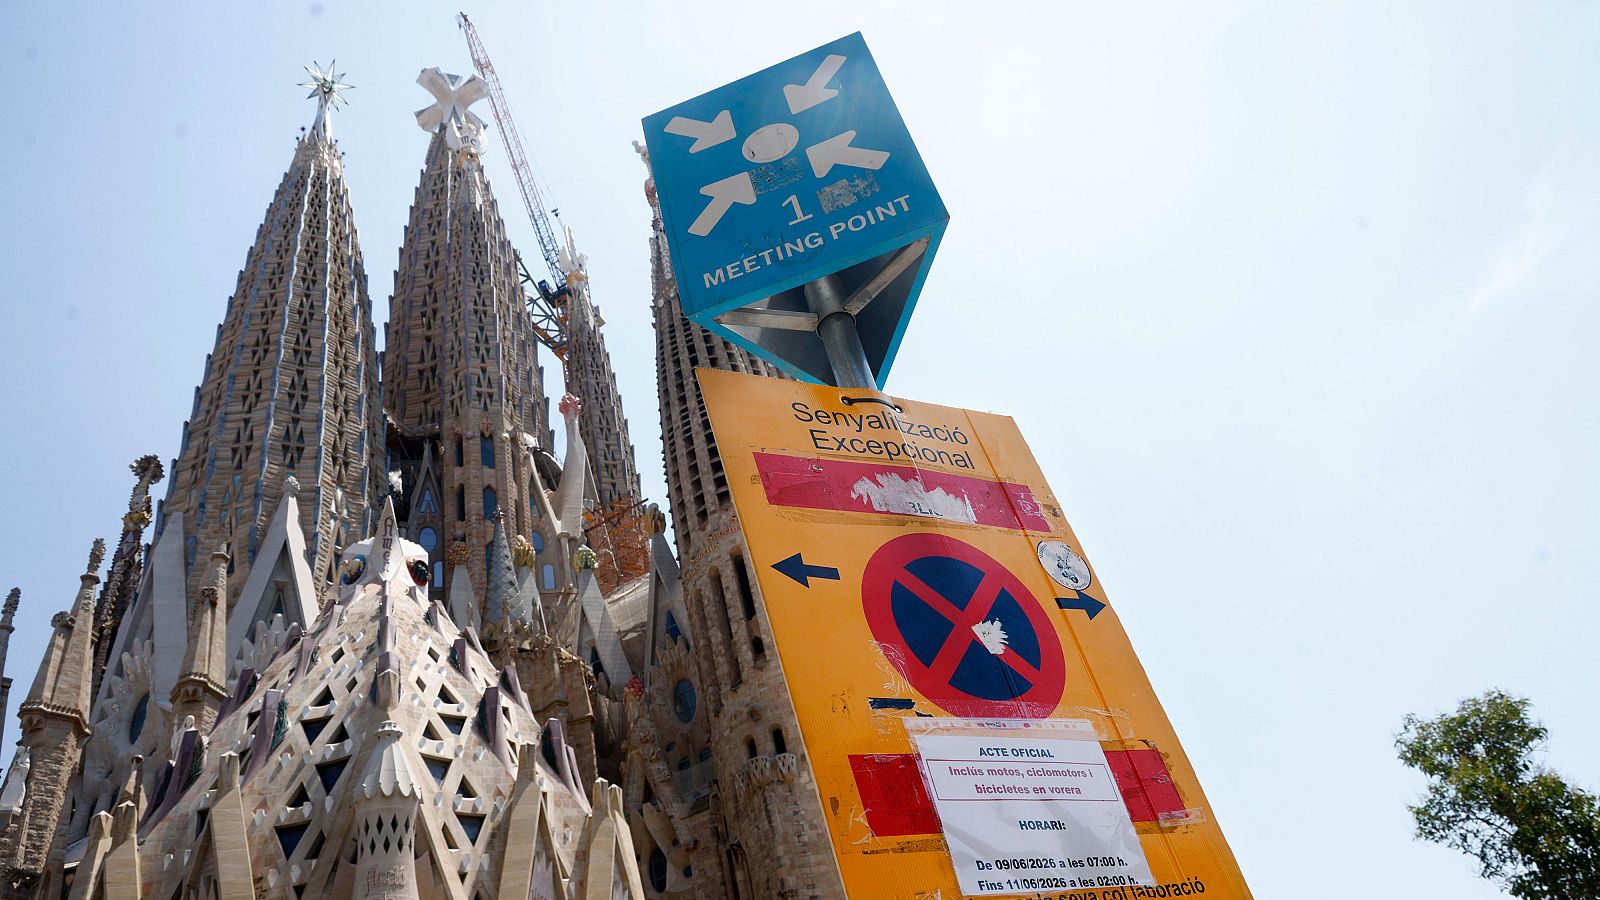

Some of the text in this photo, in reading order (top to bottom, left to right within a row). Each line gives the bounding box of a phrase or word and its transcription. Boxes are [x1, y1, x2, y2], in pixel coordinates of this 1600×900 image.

[782, 195, 813, 226] 1
[703, 194, 910, 288] MEETING POINT
[791, 402, 969, 445] Senyalització
[809, 429, 976, 469] Excepcional
[979, 747, 1054, 758] ACTE OFICIAL
[949, 766, 984, 776] Inclús
[987, 767, 1025, 778] motos,
[1026, 767, 1087, 777] ciclomotors
[975, 784, 1081, 795] bicicletes en vorera
[1018, 820, 1066, 831] HORARI:
[976, 860, 993, 870] De
[995, 858, 1056, 870] 09/06/2026
[1067, 858, 1085, 868] les
[1086, 856, 1116, 867] 07:00
[1117, 856, 1128, 866] h.
[977, 875, 1139, 891] Fins 11/06/2026 a les 02:00 h.
